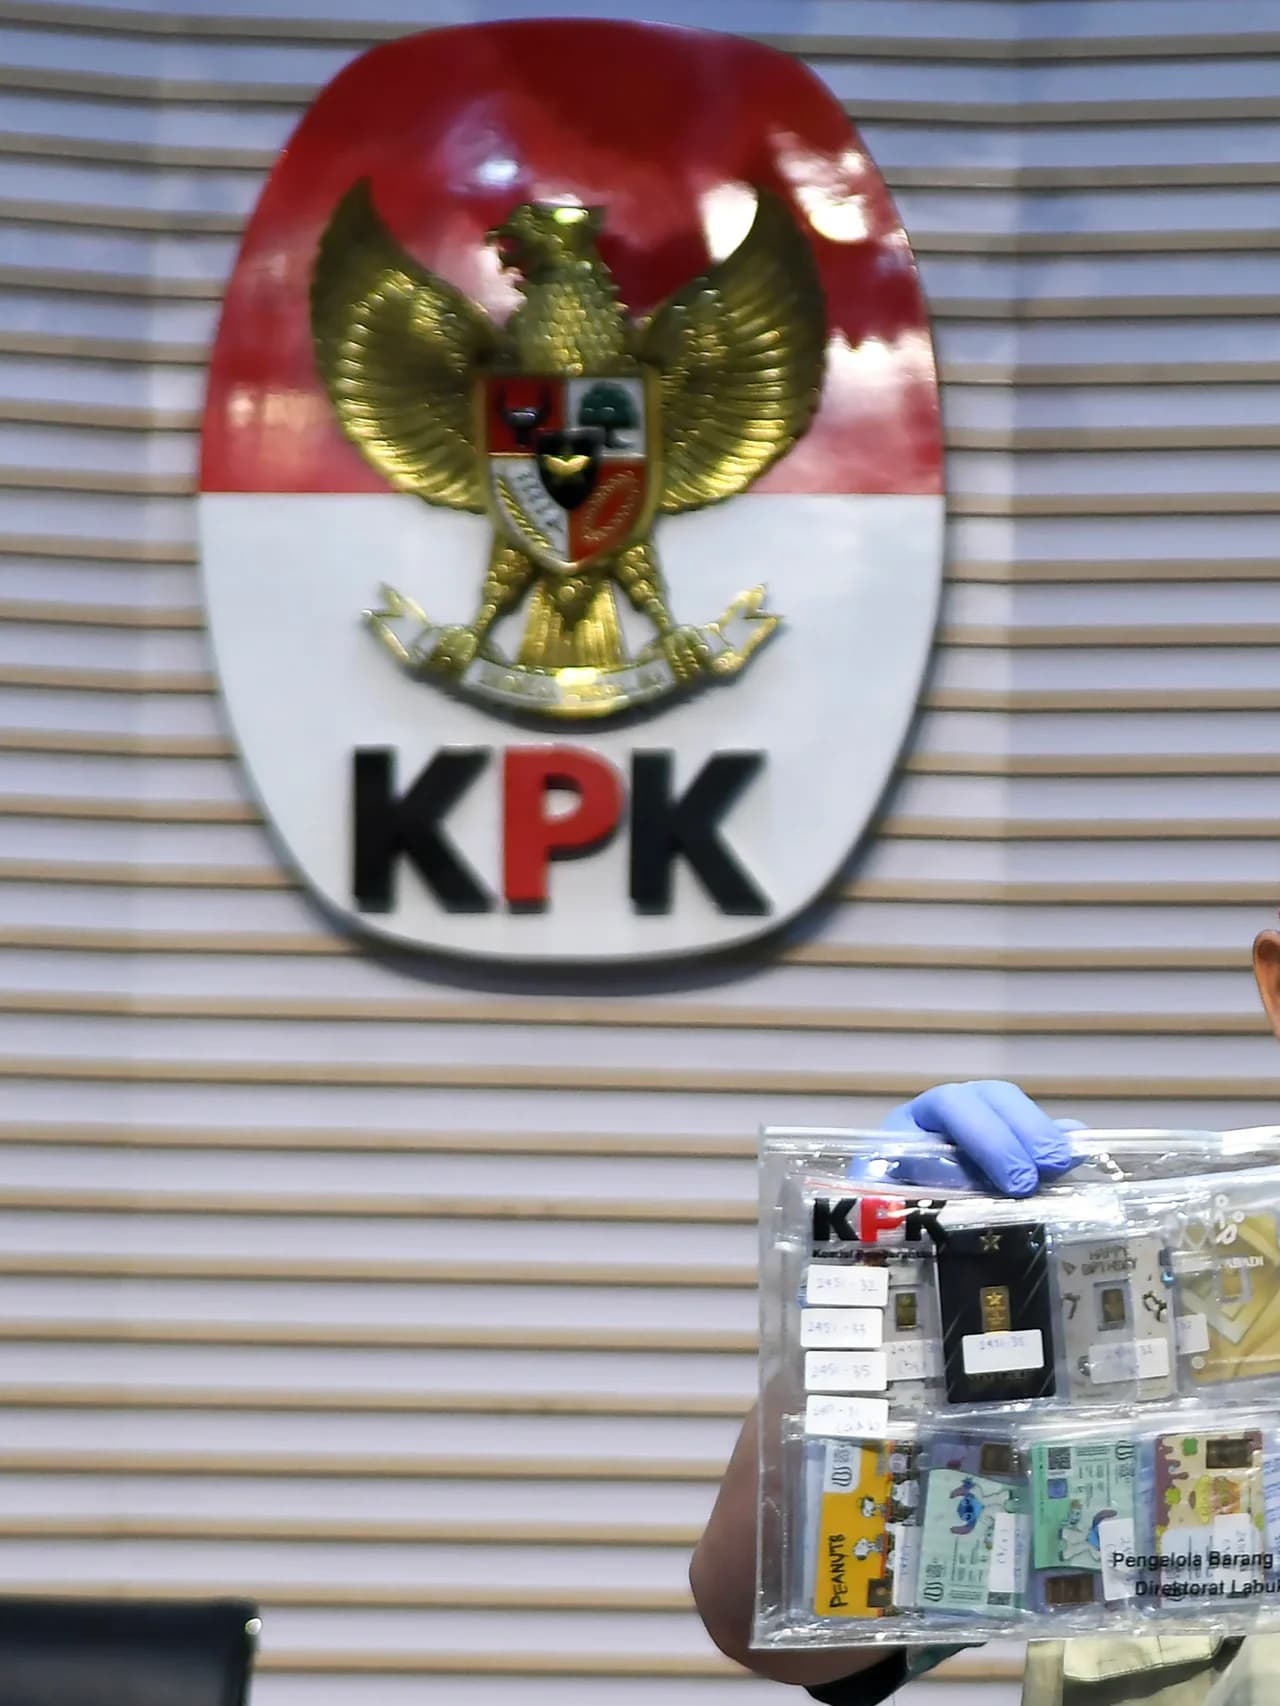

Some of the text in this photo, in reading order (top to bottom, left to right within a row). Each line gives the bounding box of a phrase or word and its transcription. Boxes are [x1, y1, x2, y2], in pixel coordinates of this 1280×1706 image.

[351, 743, 772, 916] KPK
[812, 1197, 949, 1245] KPK
[1113, 1551, 1201, 1570] Pengelola
[1208, 1550, 1273, 1568] Barang
[1135, 1580, 1225, 1597] Direktorat
